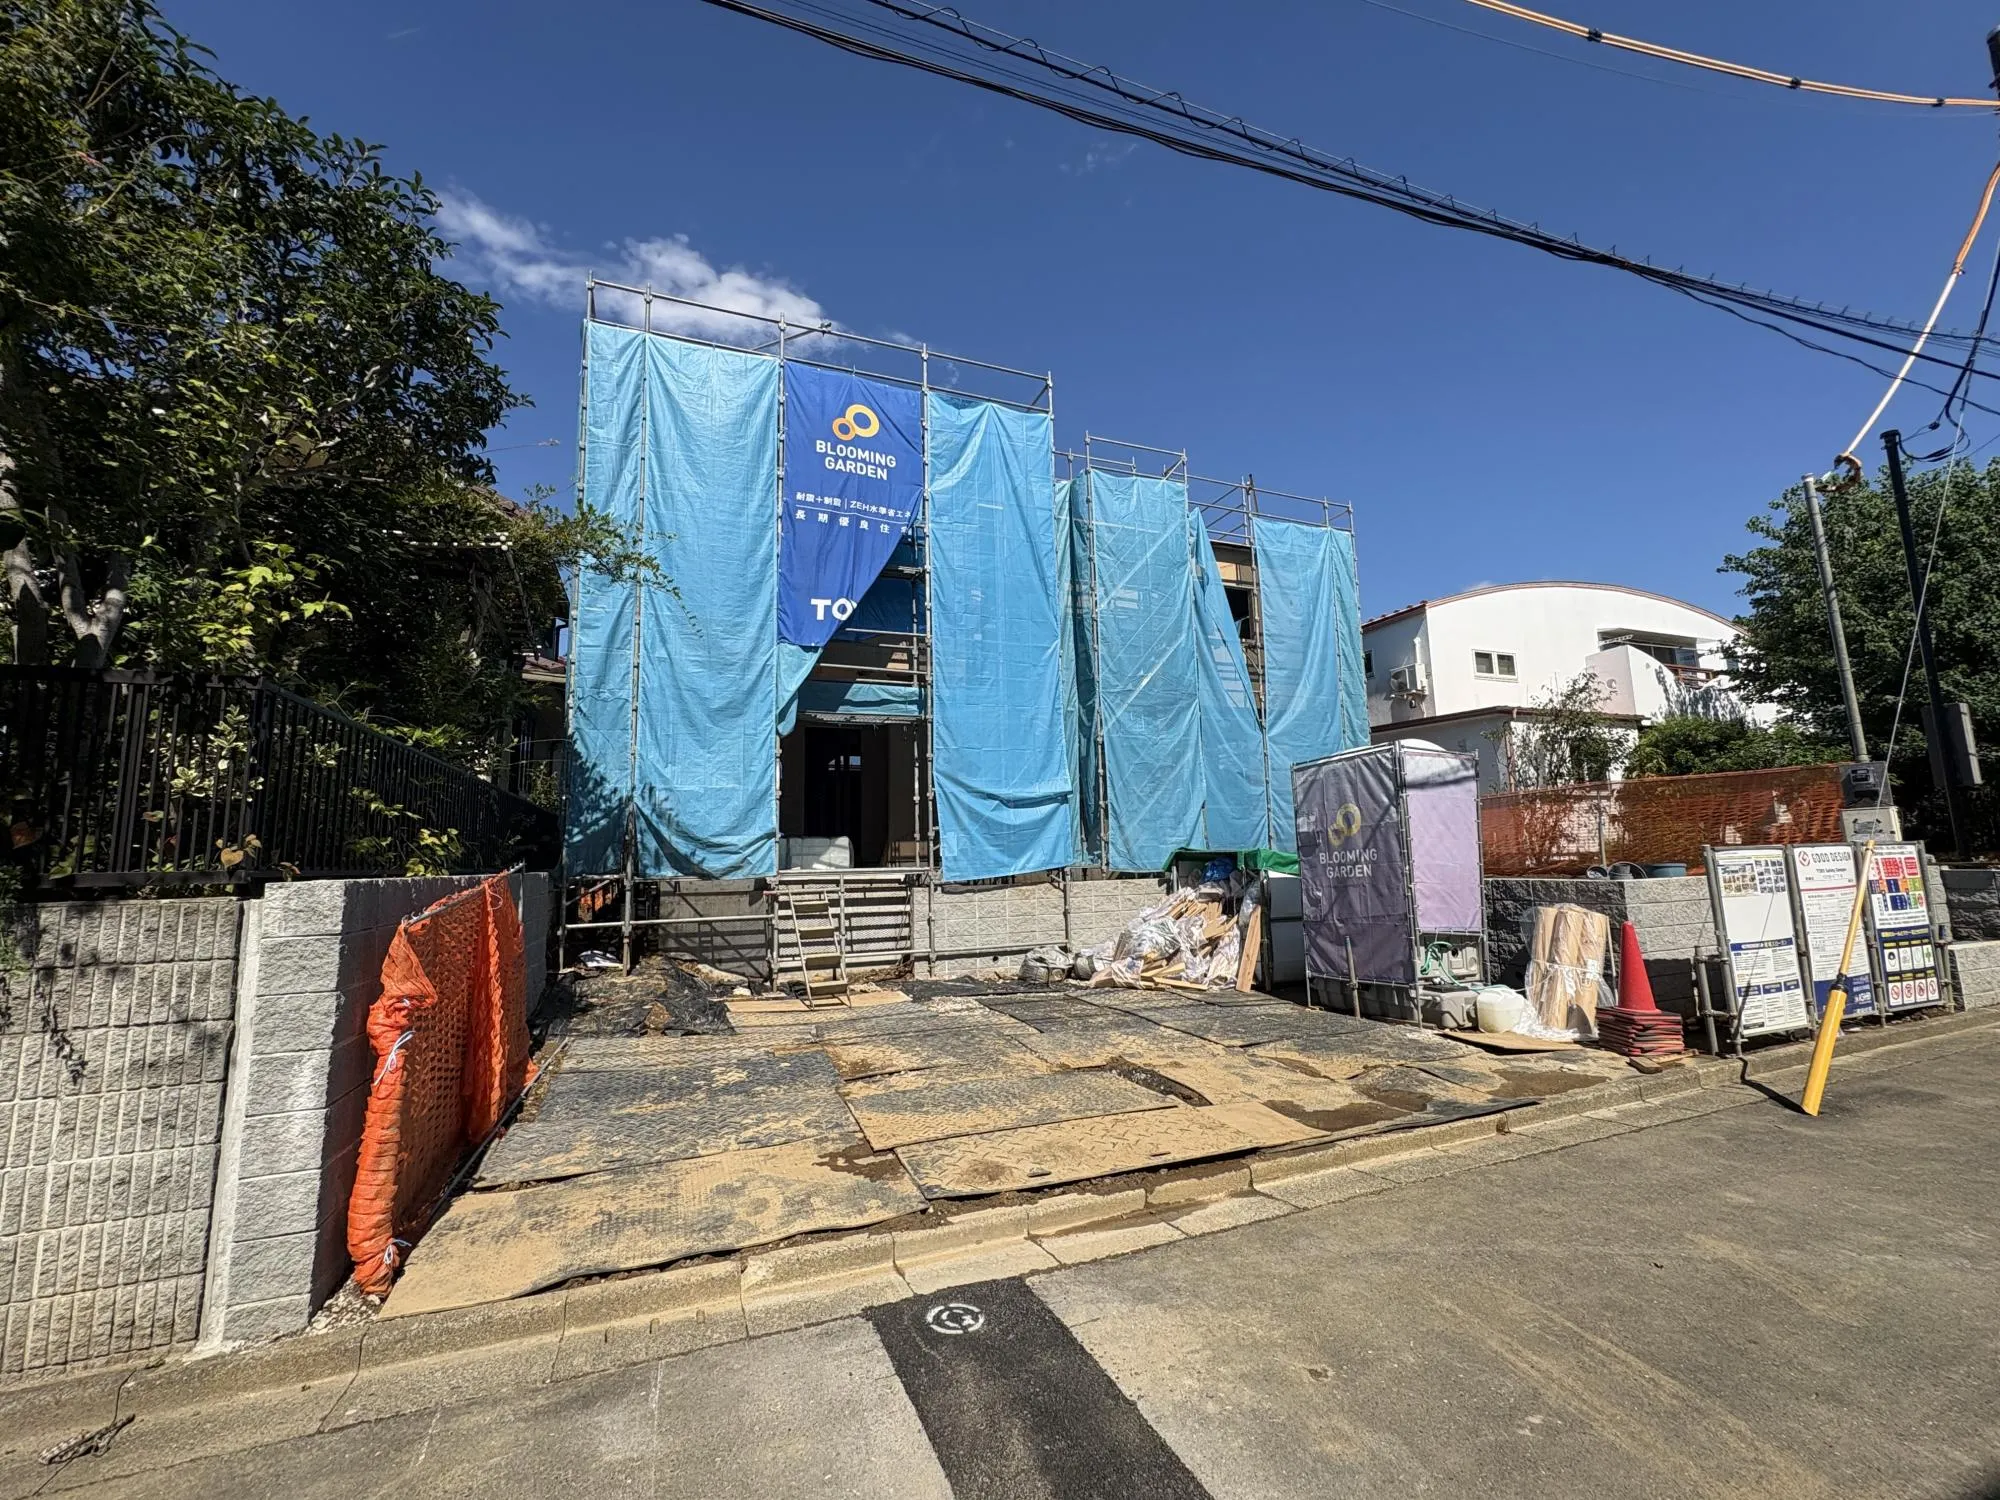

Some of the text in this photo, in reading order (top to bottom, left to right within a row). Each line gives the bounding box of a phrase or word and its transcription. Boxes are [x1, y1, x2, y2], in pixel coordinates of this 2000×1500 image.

[815, 439, 897, 468] BLOOMING
[824, 456, 888, 481] GARDEN
[1319, 848, 1378, 865] BLOOMING
[1326, 863, 1372, 879] GARDEN
